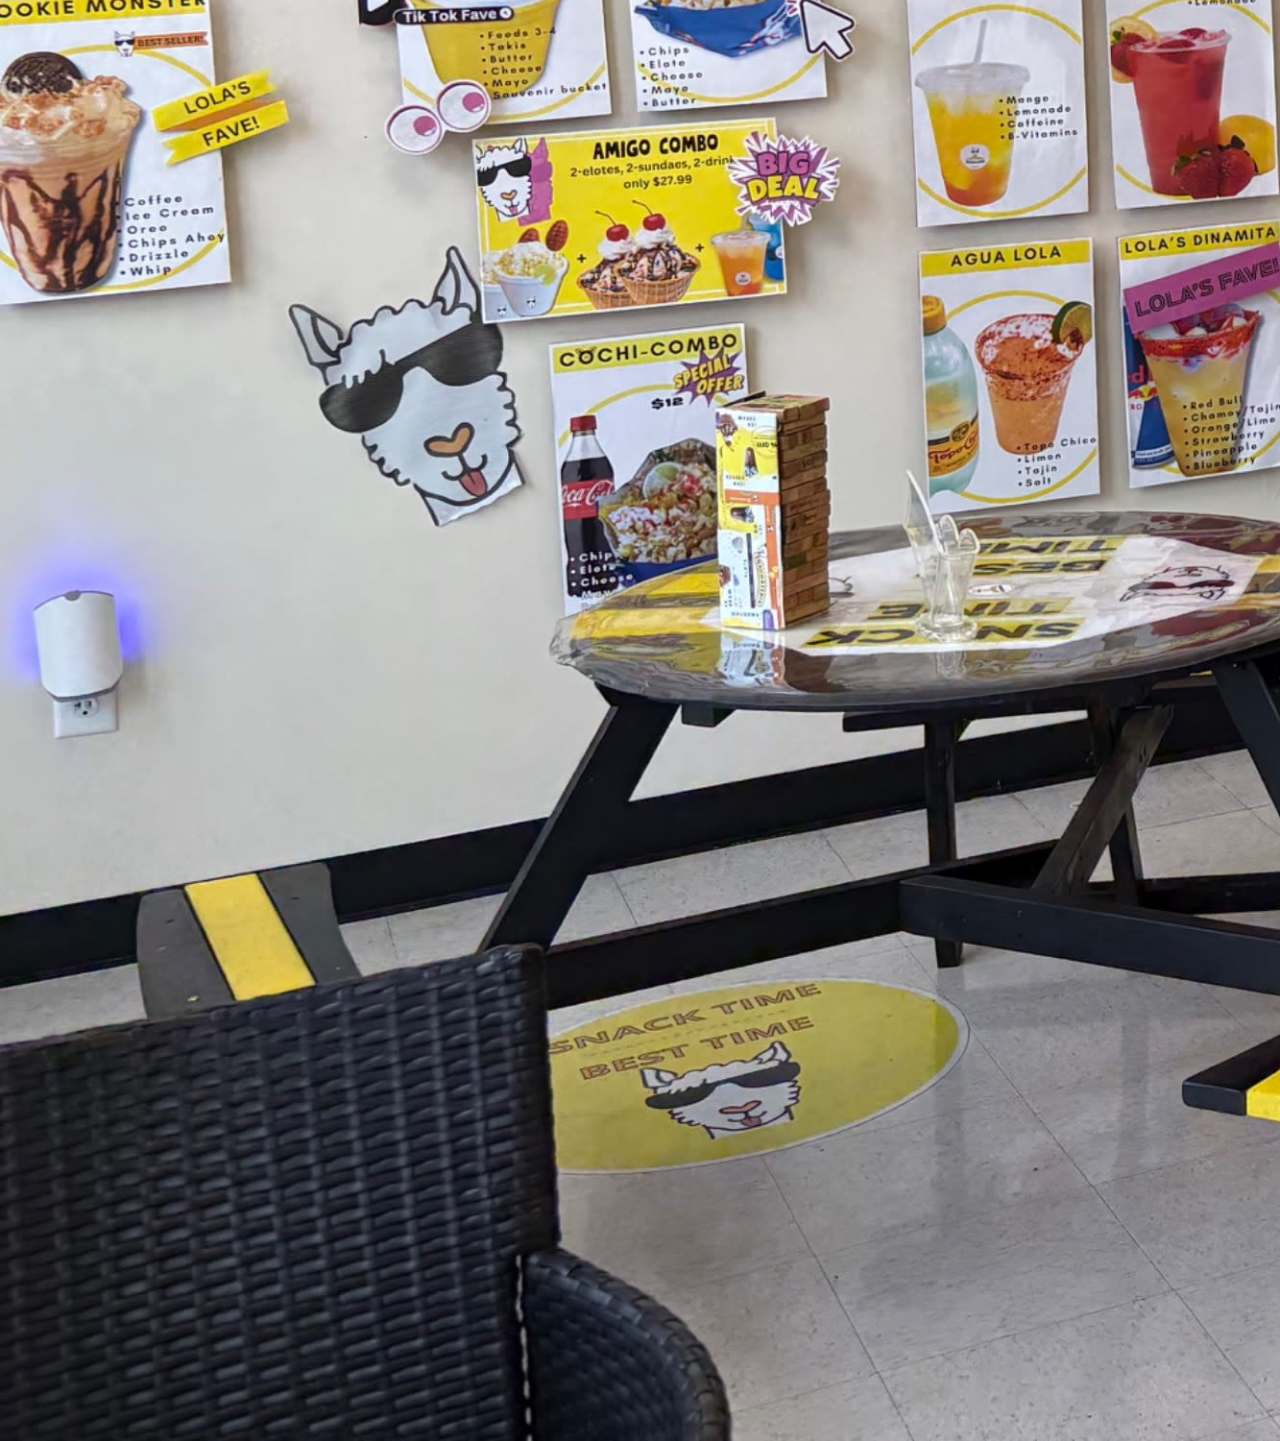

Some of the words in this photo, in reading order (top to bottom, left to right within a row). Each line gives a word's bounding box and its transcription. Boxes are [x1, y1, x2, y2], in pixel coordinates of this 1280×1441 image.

[403, 9, 426, 23] Tik
[429, 9, 453, 21] Tok
[456, 8, 498, 20] Fave
[183, 80, 252, 115] LOLA'S
[201, 116, 260, 147] FAVE!
[592, 136, 651, 161] AMIGO
[659, 133, 719, 154] COMBO
[755, 150, 811, 176] BIG
[623, 178, 650, 191] only
[652, 174, 693, 188] $27.99
[746, 175, 821, 201] DEAL
[125, 194, 183, 207] Coffee
[159, 205, 214, 218] Cream
[128, 224, 167, 235] Oreo
[128, 237, 177, 249] Chips
[185, 231, 225, 243] Ahoy
[1124, 236, 1187, 254] LOLA'S
[1193, 227, 1276, 246] DINAMITA
[951, 251, 1005, 268] AGUA
[1012, 245, 1062, 263] LOLA
[130, 264, 172, 276] Whip
[1134, 278, 1215, 318] LOLA'S
[1219, 257, 1280, 292] FAVE!
[560, 333, 737, 367] COCHI-COMBO
[673, 355, 730, 390] SPECIAL
[696, 372, 744, 396] OFFER
[651, 396, 684, 410] $12
[548, 1009, 706, 1055] SNACK
[710, 983, 822, 1016] TIME
[579, 1043, 689, 1081] BEST
[699, 1015, 815, 1051] TIME
